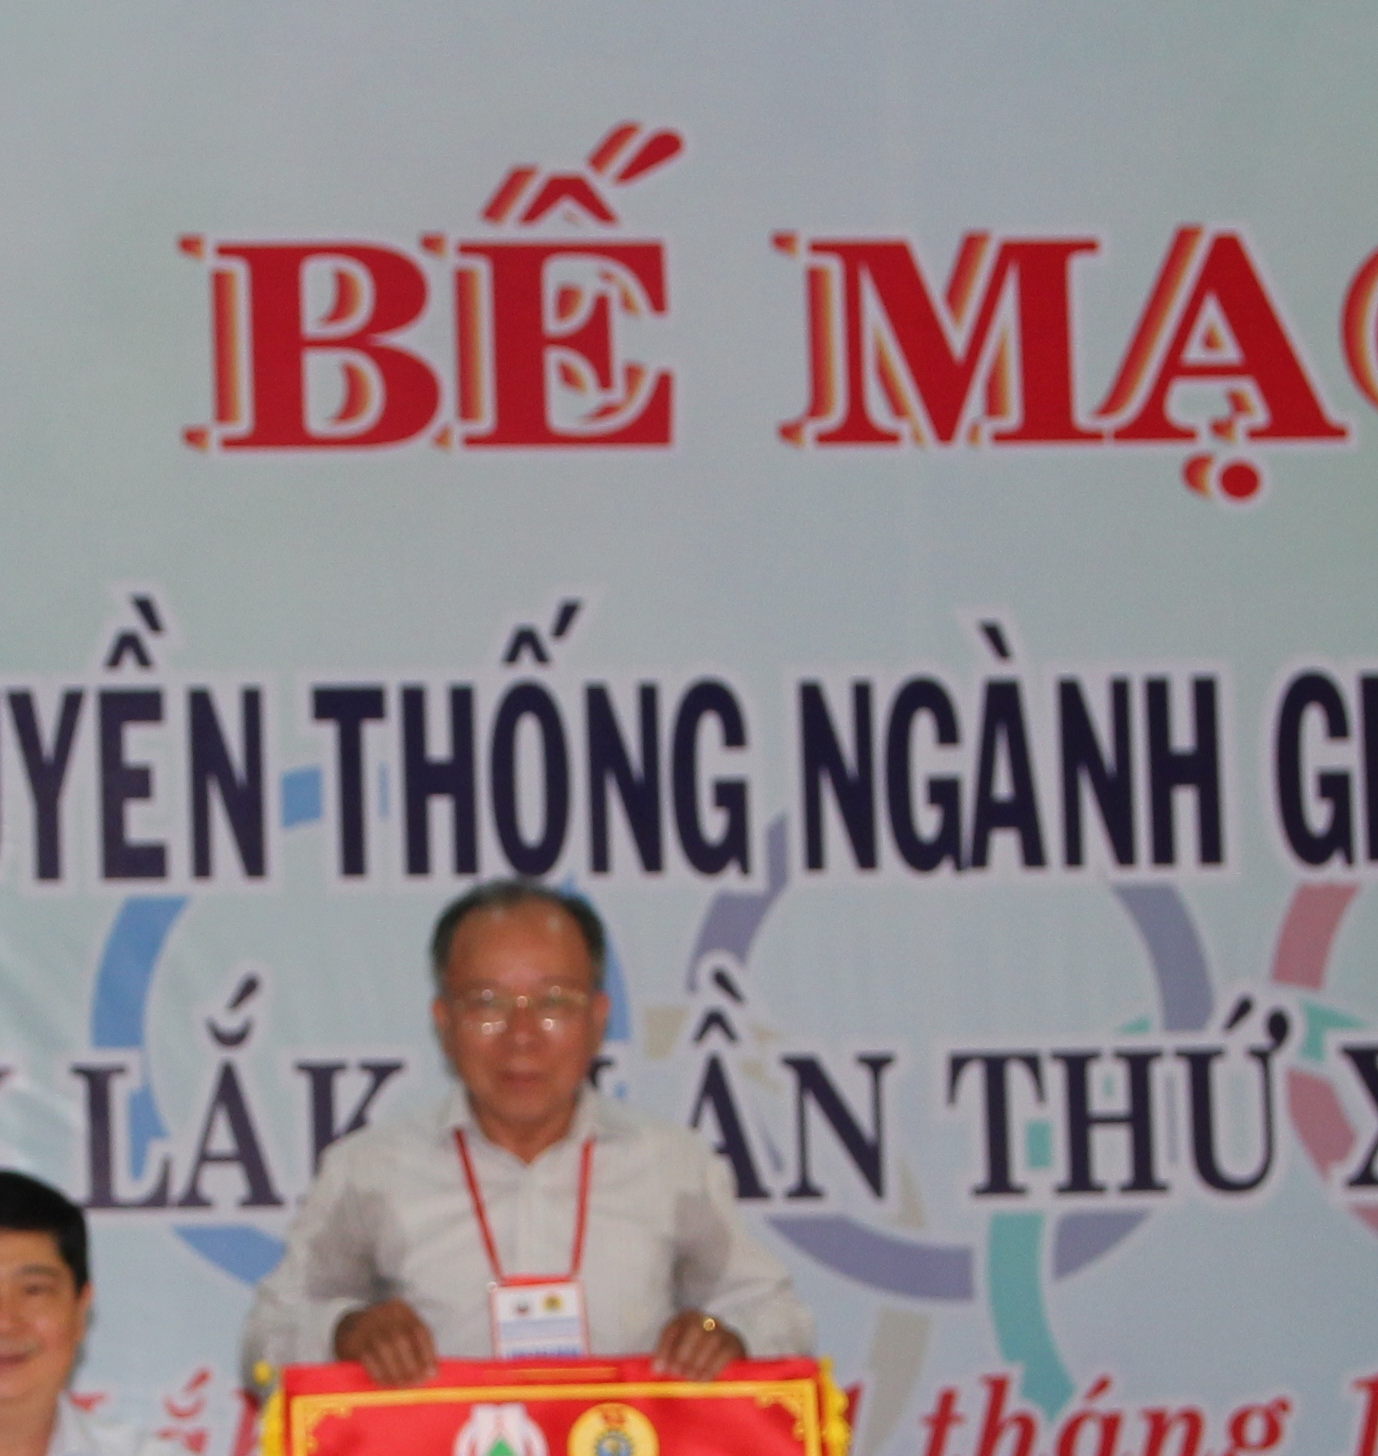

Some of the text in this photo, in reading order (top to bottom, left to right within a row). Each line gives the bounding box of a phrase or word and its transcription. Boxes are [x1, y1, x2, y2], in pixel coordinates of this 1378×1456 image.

[179, 123, 684, 450] BẾ
[311, 600, 751, 880] THỐNG
[798, 621, 1227, 872] NGÀNH
[586, 968, 897, 1200] ẦN
[946, 996, 1293, 1197] THỨ
